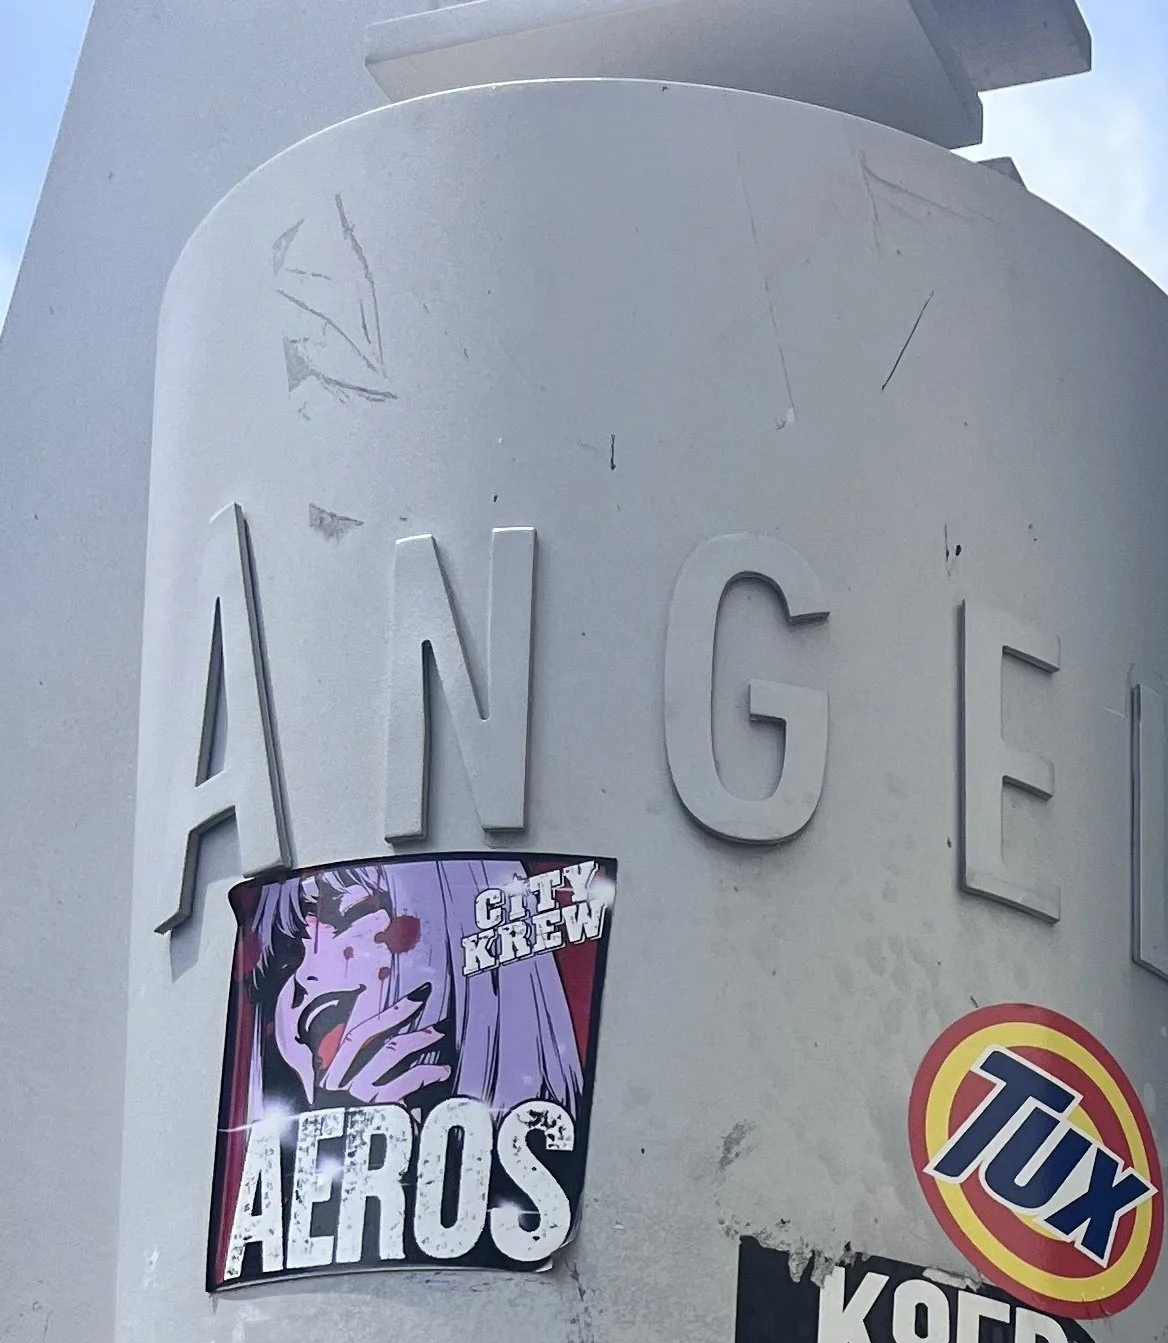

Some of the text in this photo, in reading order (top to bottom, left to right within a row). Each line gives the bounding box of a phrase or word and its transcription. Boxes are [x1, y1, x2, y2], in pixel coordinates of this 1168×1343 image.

[474, 860, 598, 930] CITY
[461, 898, 606, 977] KREW
[222, 1096, 577, 1285] AEROS
